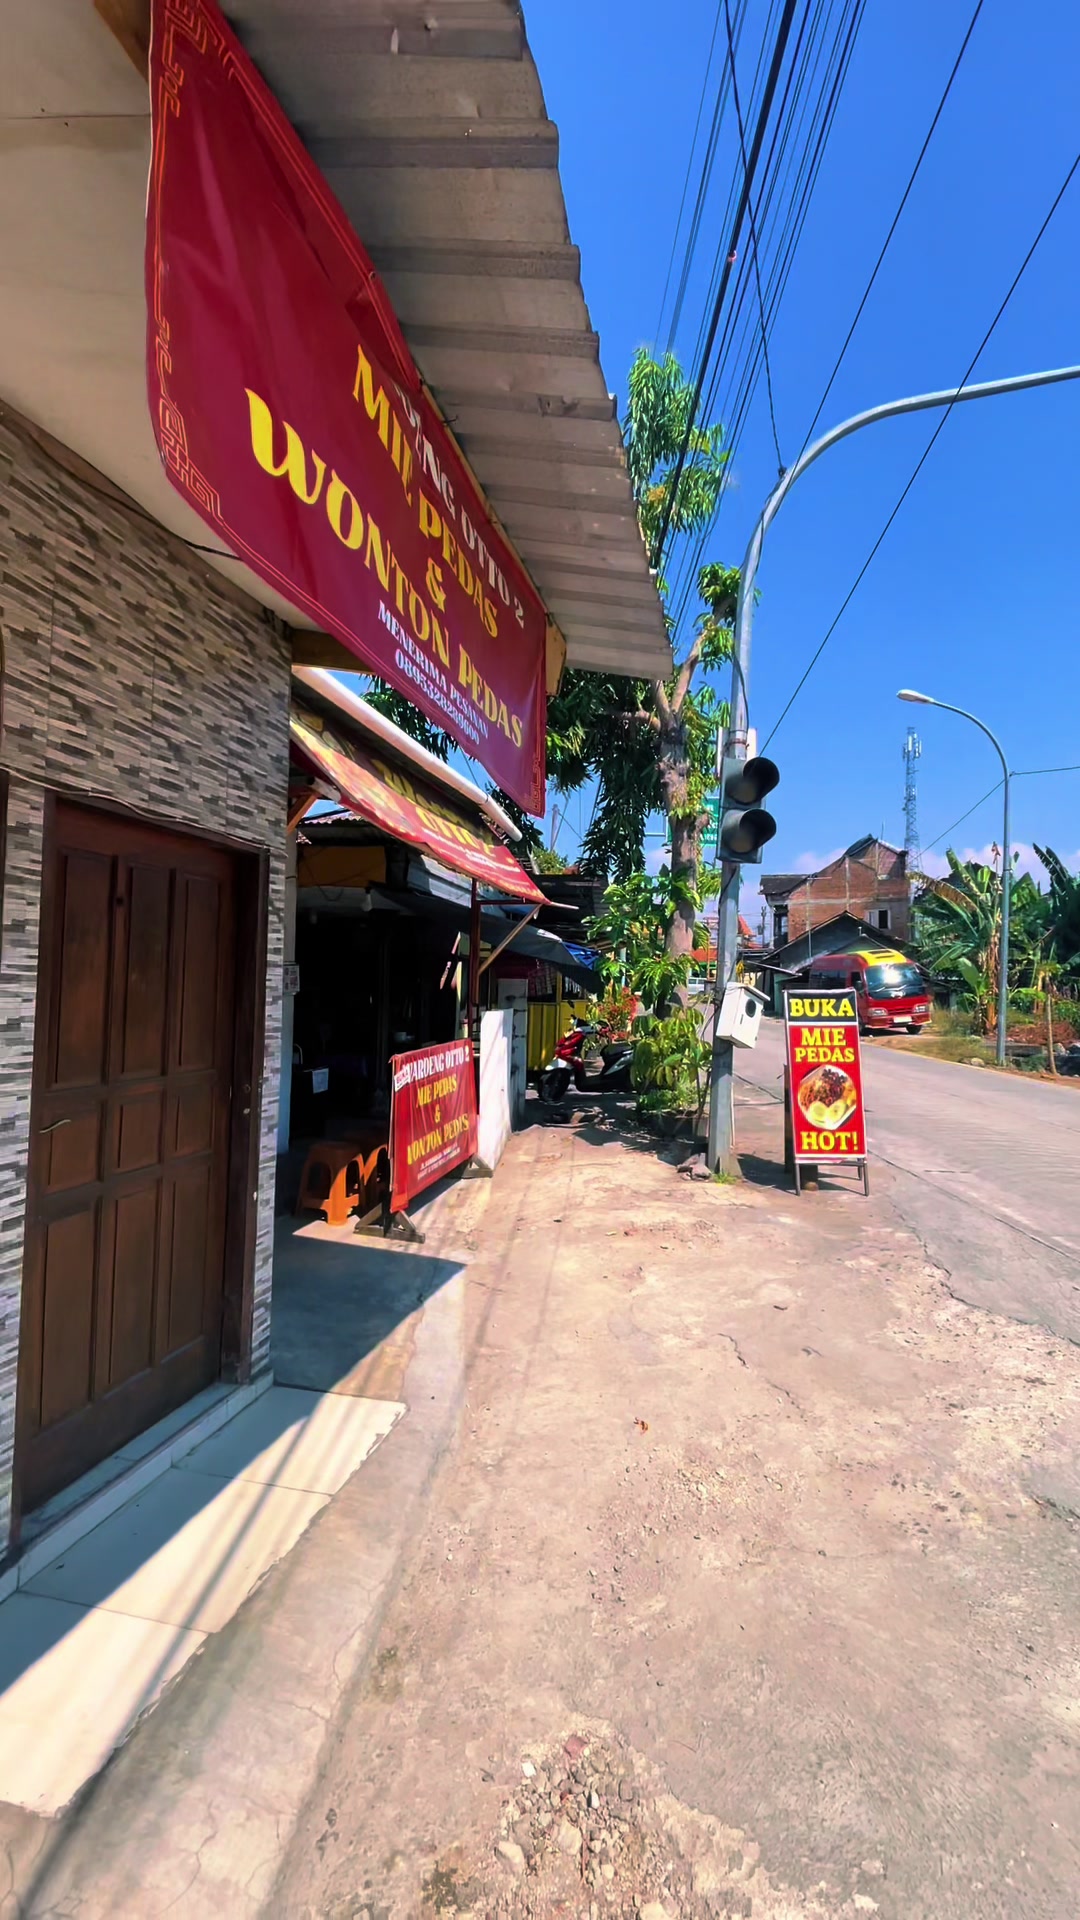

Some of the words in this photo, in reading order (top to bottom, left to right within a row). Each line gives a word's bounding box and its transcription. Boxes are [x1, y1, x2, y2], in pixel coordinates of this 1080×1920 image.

[245, 387, 450, 668] WONTON
[458, 643, 525, 749] PEDAS
[419, 489, 498, 638] PEDAS
[461, 505, 511, 606] OTTO
[514, 599, 525, 629] 2
[426, 557, 446, 612] &
[378, 600, 448, 693] MENERIMA
[450, 683, 489, 740] PESANAN
[790, 998, 855, 1018] BUKA
[801, 1028, 847, 1047] MIE
[446, 1047, 464, 1069] OTTO
[795, 1047, 855, 1063] PEDAS
[434, 1103, 441, 1124] &
[800, 1131, 859, 1151] HOT!
